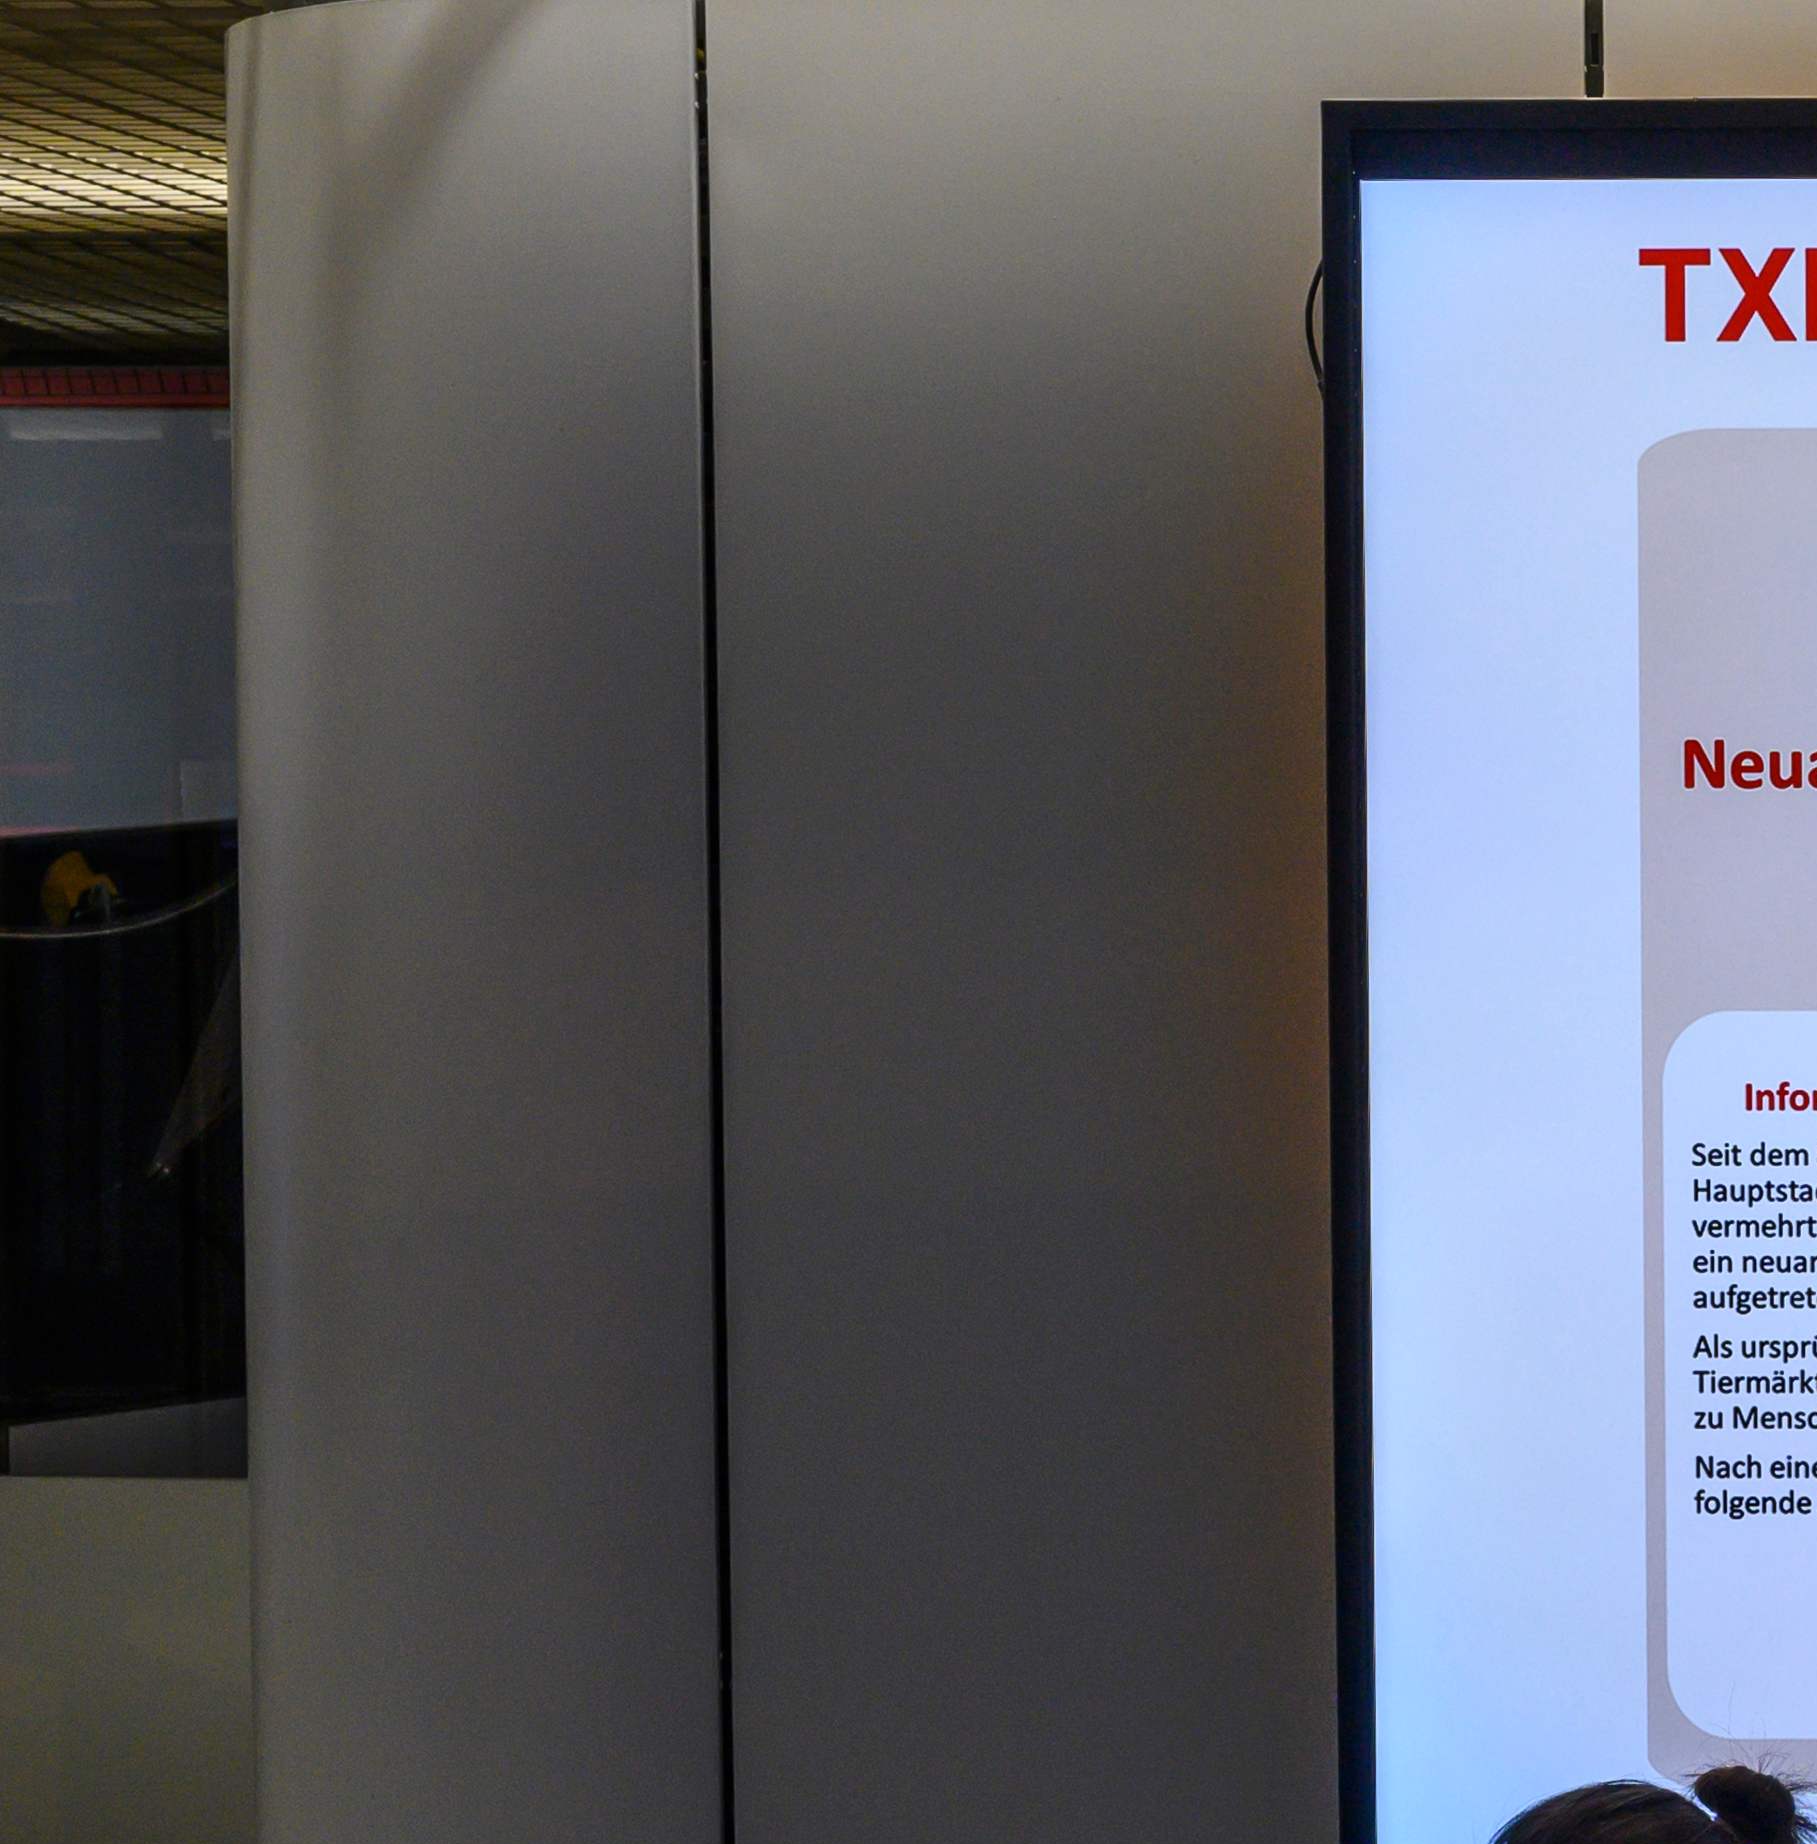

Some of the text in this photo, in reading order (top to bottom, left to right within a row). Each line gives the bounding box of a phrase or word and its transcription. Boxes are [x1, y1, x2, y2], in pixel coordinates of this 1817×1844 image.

[1691, 1142, 1743, 1167] Seit
[1749, 1140, 1810, 1167] dem
[1691, 1212, 1817, 1239] vermehrt
[1692, 1249, 1734, 1274] ein
[1692, 1332, 1734, 1360] Als
[1693, 1410, 1724, 1430] zu
[1695, 1453, 1763, 1480] Nach
[1693, 1488, 1813, 1521] folgende
